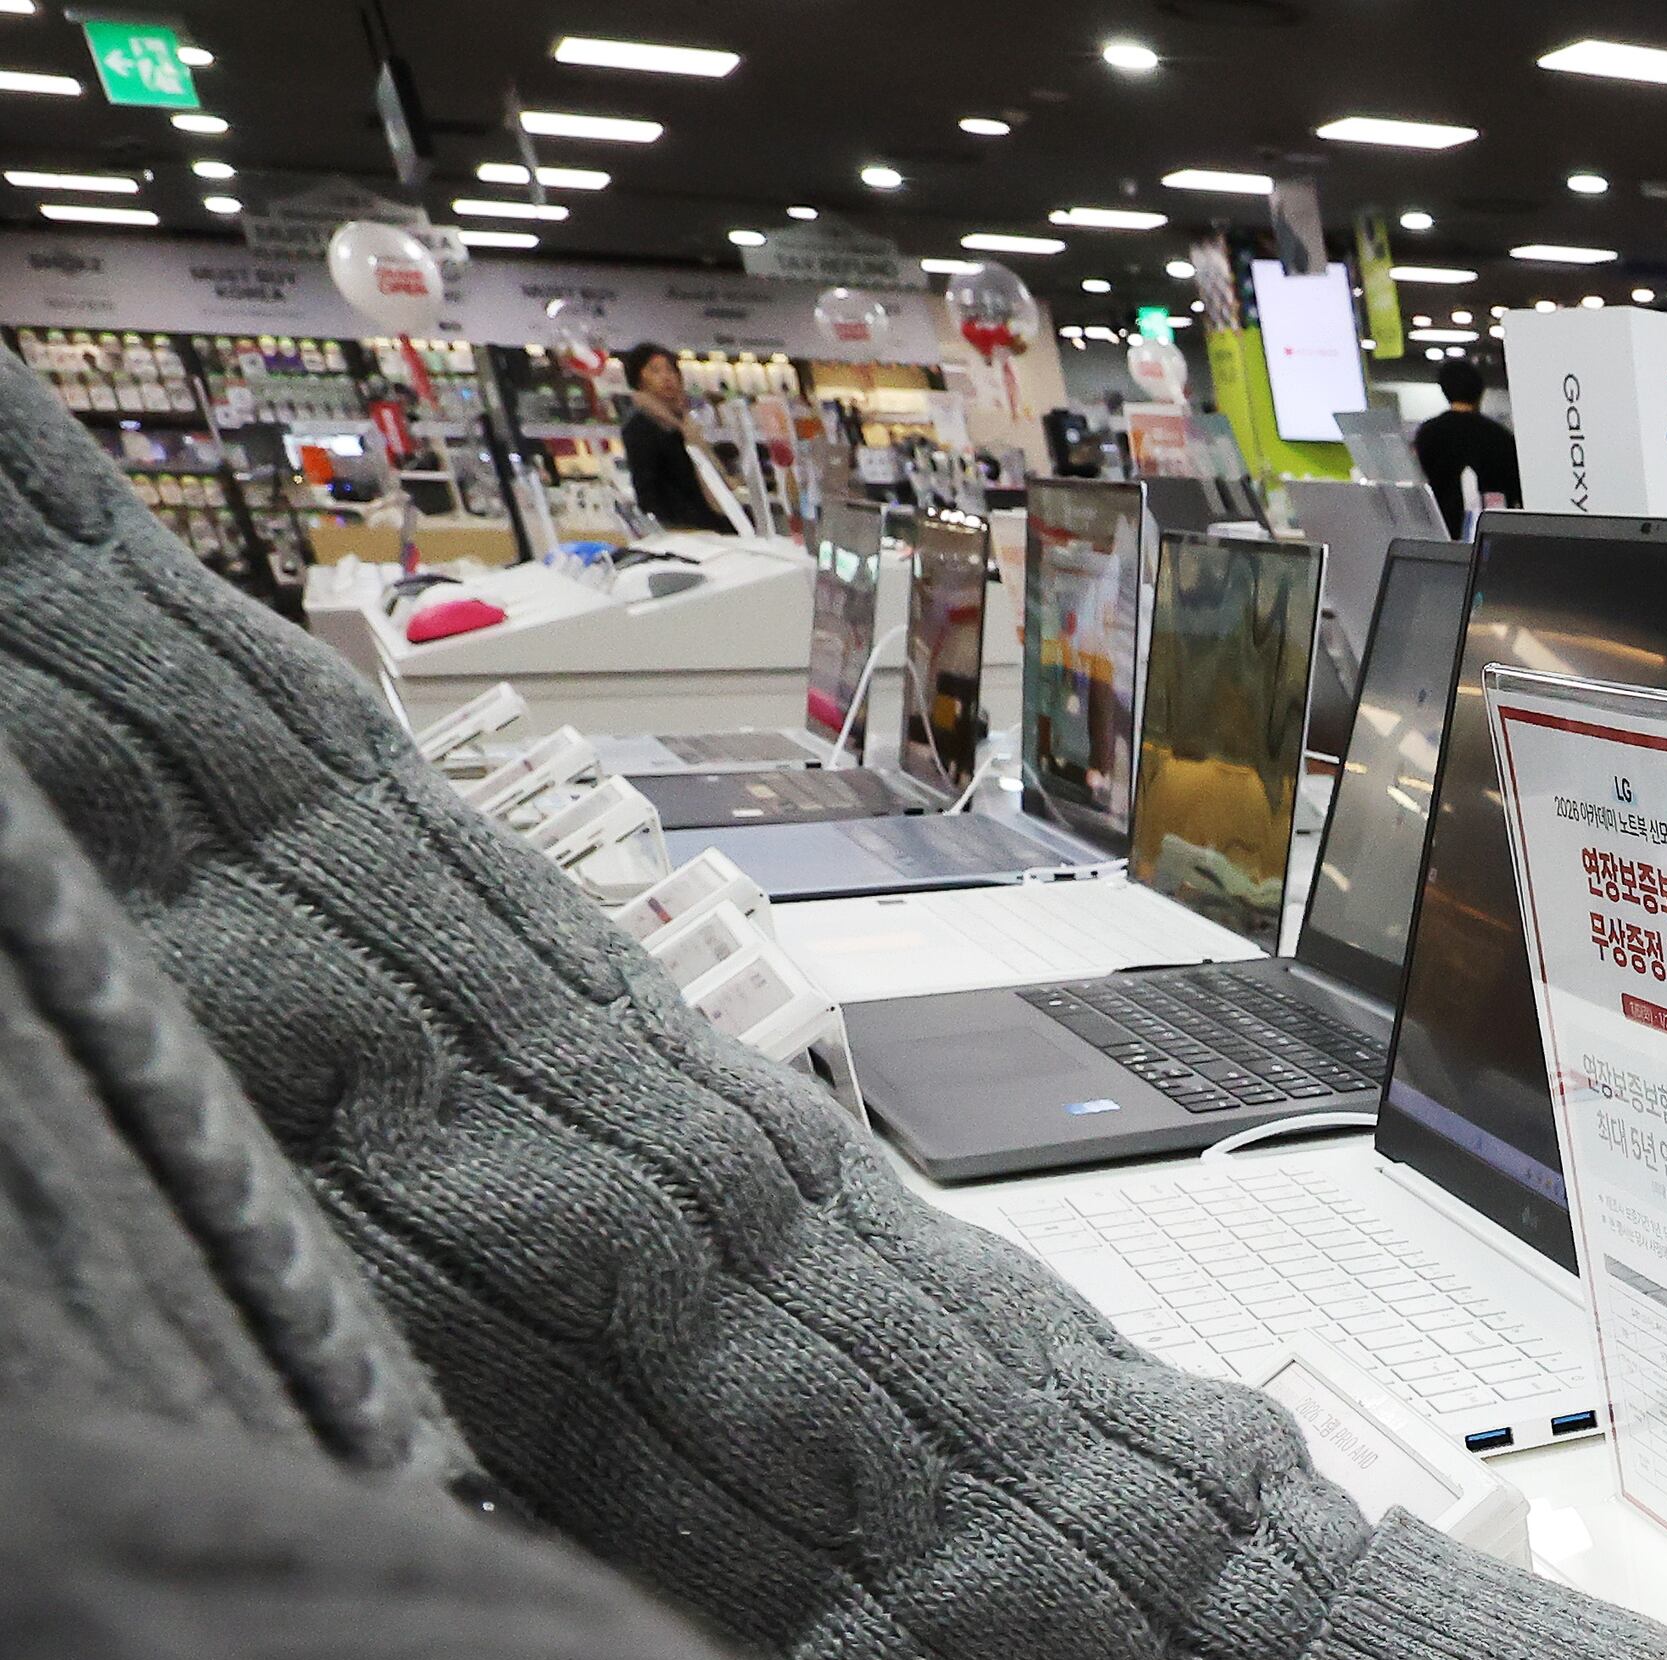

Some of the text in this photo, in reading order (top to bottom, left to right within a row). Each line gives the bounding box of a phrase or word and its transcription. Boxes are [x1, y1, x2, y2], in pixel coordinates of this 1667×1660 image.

[1563, 373, 1588, 512] Galaxy
[1554, 796, 1580, 821] 2026
[1580, 800, 1618, 831] 아카데미
[1619, 812, 1648, 842] 노트북
[1613, 775, 1633, 803] LG
[1589, 911, 1667, 982] 무상증정
[1597, 1108, 1629, 1159] 최대
[1631, 1126, 1658, 1172] 5년
